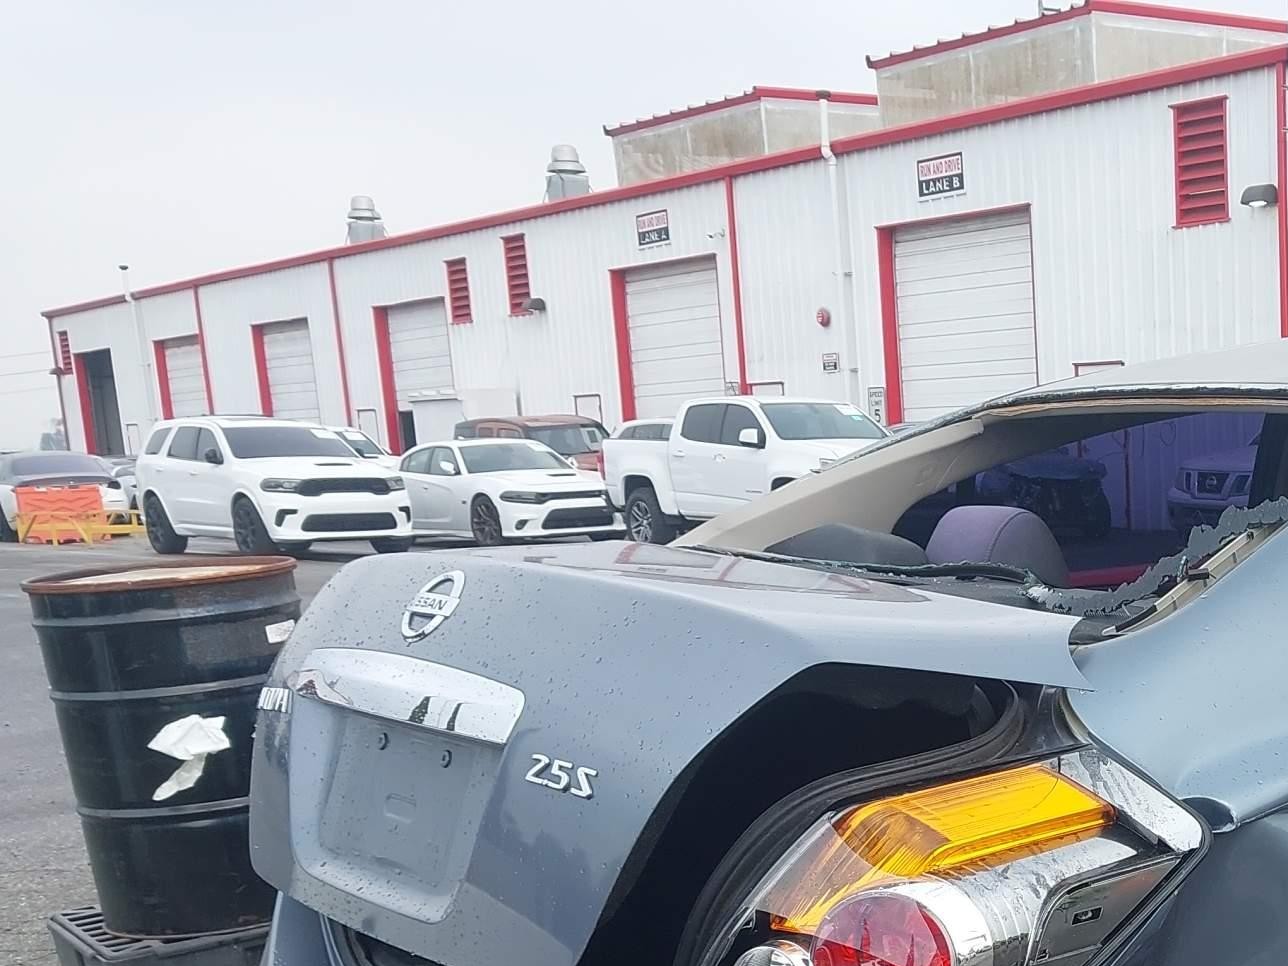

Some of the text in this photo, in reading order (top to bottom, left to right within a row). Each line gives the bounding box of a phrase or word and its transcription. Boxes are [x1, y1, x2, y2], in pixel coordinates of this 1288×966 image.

[933, 160, 943, 175] AND
[922, 176, 961, 194] LANE B
[874, 408, 882, 423] 5
[406, 596, 448, 611] SSAN
